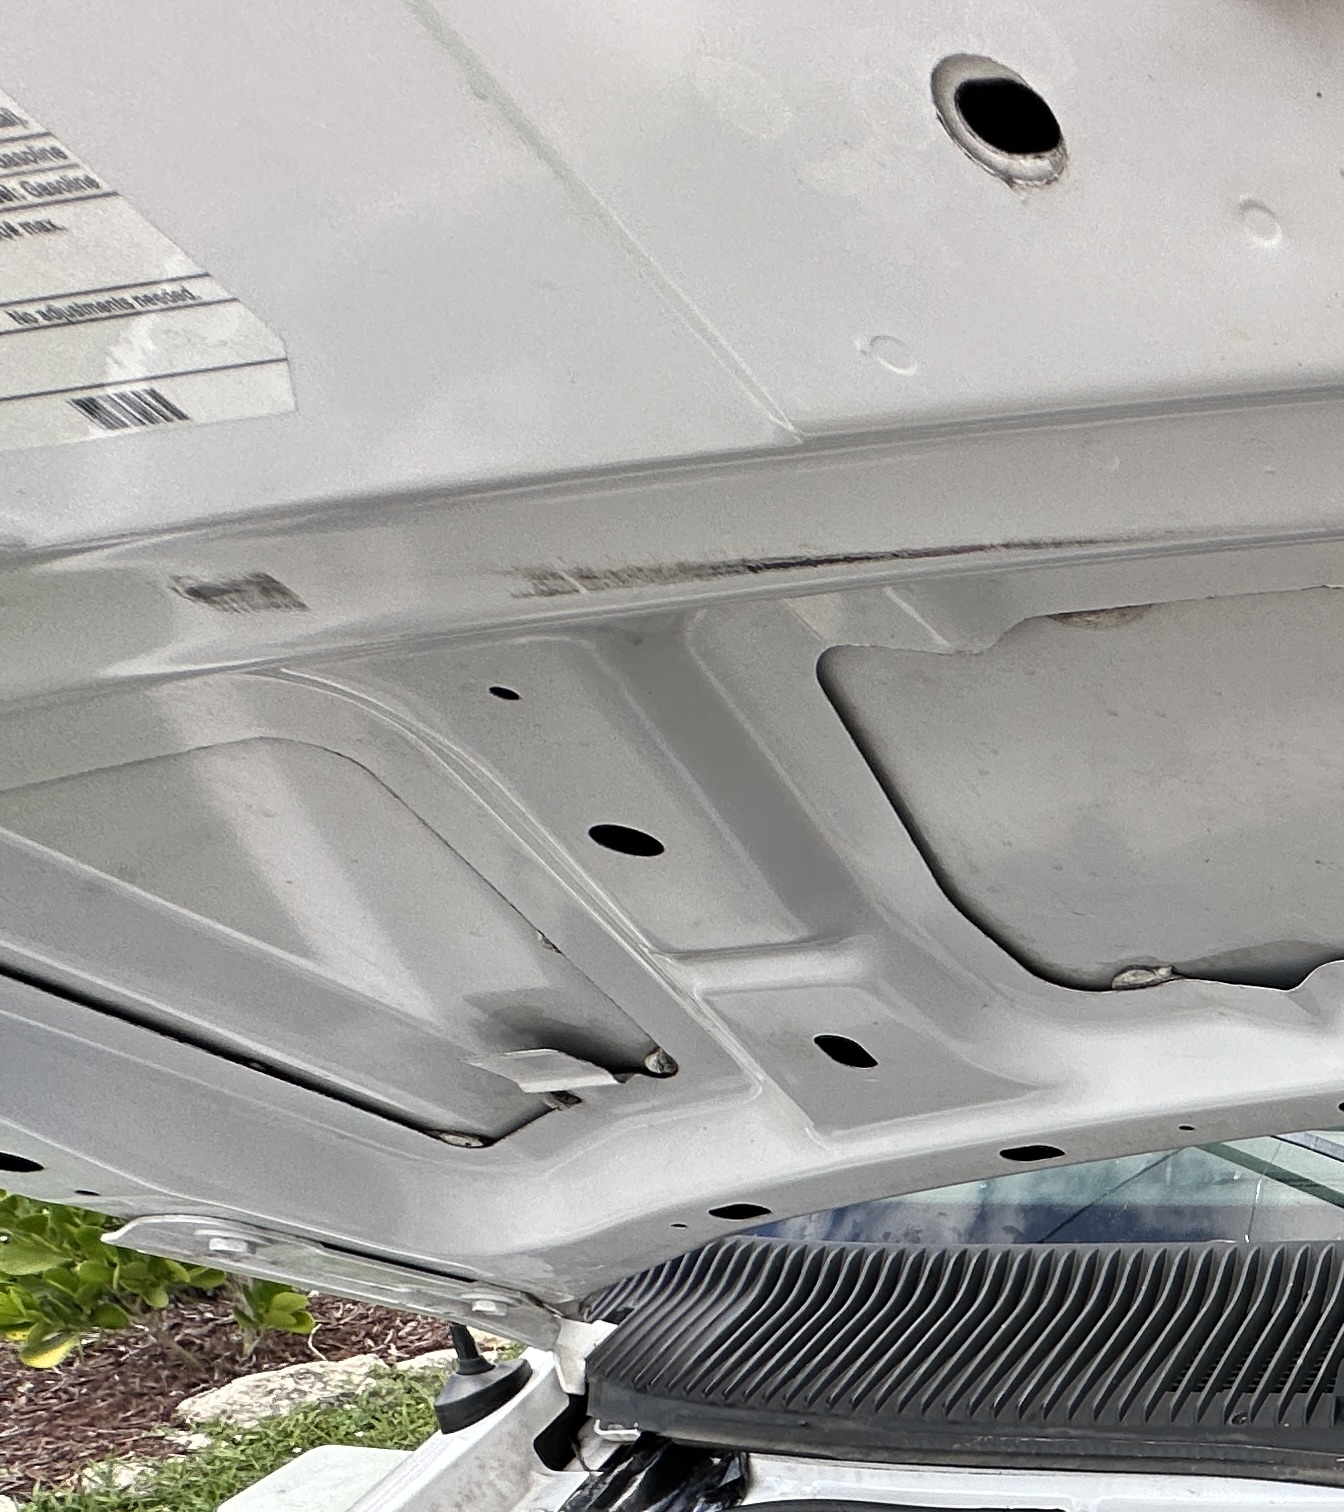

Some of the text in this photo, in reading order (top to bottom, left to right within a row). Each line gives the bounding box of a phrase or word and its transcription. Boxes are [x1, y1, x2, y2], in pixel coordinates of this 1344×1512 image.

[0, 146, 69, 169] asoline
[18, 174, 101, 199] Gasoline
[8, 286, 202, 326] No adjustments needed.
